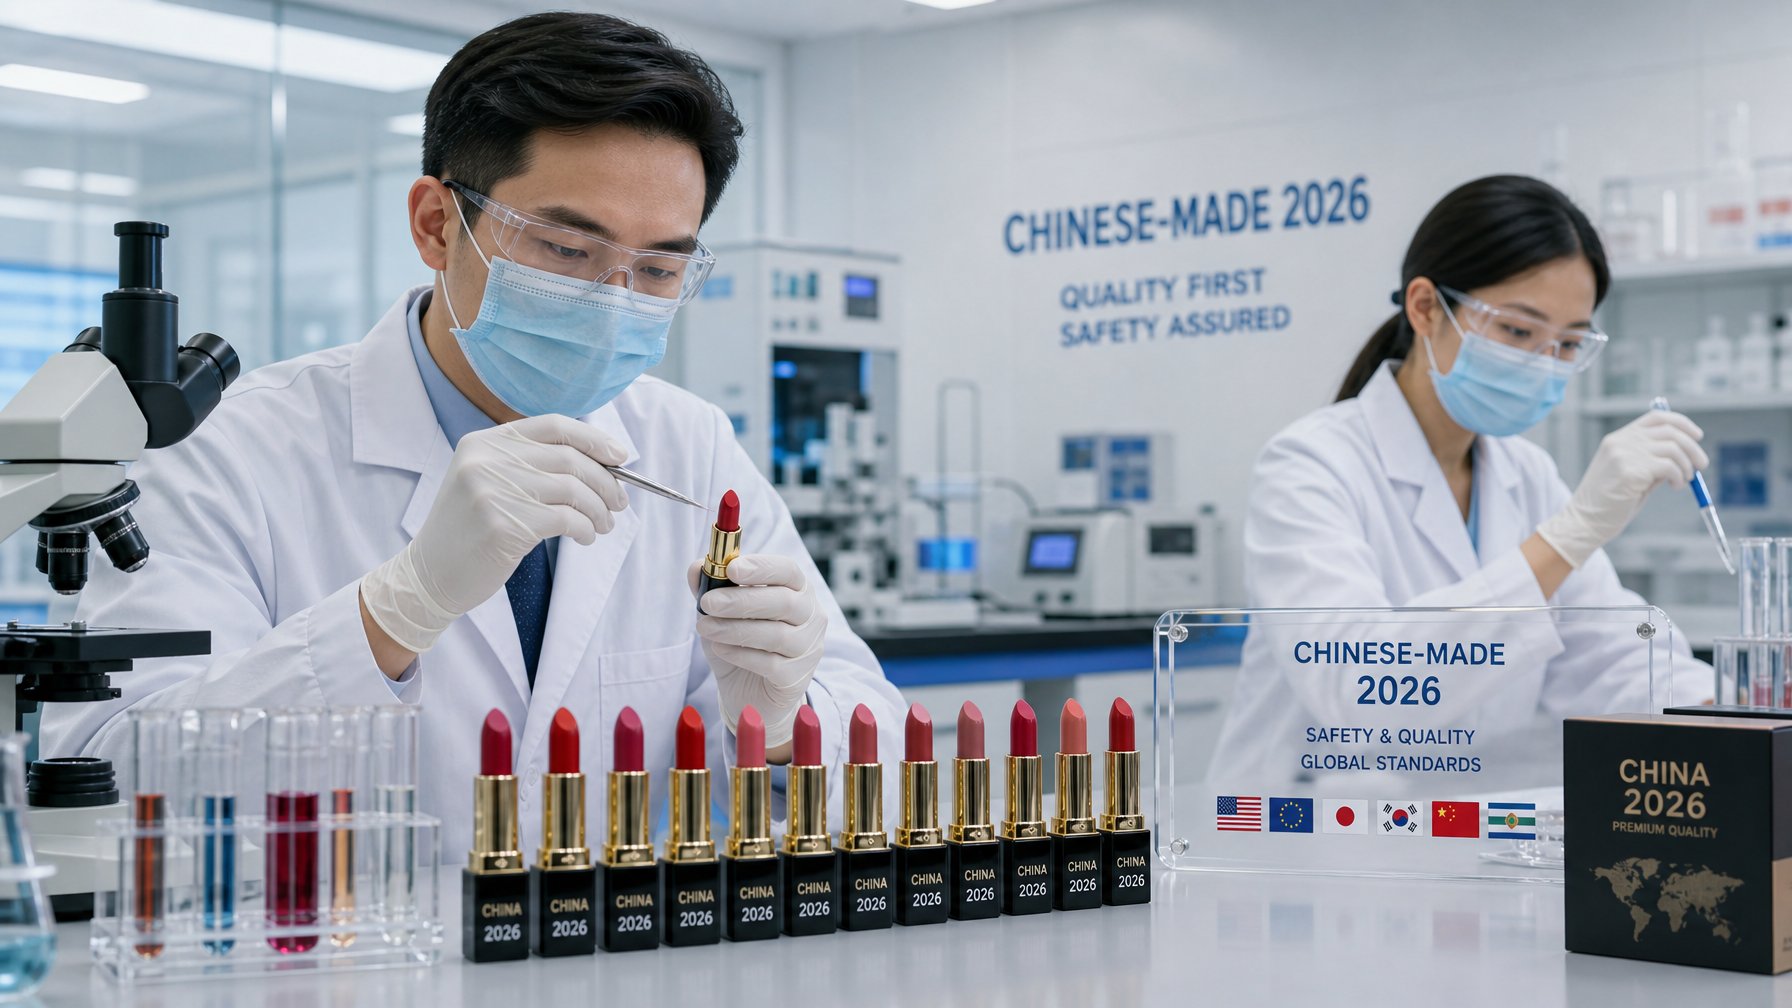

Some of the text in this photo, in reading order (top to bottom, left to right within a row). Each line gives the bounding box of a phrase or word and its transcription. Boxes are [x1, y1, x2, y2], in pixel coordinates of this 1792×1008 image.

[1003, 176, 1370, 255] CHINESE-MADE 2026
[1060, 267, 1266, 312] QUALITY FIRST
[1060, 305, 1291, 348] SAFETY ASSURED
[1294, 641, 1505, 665] CHINESE-MADE
[1357, 676, 1440, 705] 2026
[1307, 727, 1475, 745] SAFETY & QUALITY
[1301, 754, 1481, 772] GLOBAL STANDARDS
[1620, 759, 1710, 787] CHINA
[1623, 788, 1706, 819] 2026
[1613, 821, 1718, 838] PREMIUM QUALITY
[1068, 860, 1097, 872] CHINA
[1117, 856, 1145, 867] CHINA
[965, 869, 995, 881] CHINA
[1018, 864, 1047, 876] CHINA
[855, 877, 887, 890] CHINA
[911, 873, 942, 885] CHINA
[1070, 878, 1096, 892] 2026
[1119, 874, 1144, 887] 2026
[740, 886, 774, 899] CHINA
[798, 881, 831, 895] CHINA
[967, 887, 994, 902] 2026
[1019, 882, 1046, 897] 2026
[616, 894, 653, 908] CHINA
[678, 890, 714, 904] CHINA
[857, 897, 886, 912] 2026
[913, 892, 941, 906] 2026
[482, 902, 522, 918] CHINA
[550, 898, 589, 913] CHINA
[799, 901, 830, 917] 2026
[680, 910, 713, 927] 2026
[742, 906, 773, 922] 2026
[552, 919, 587, 937] 2026
[618, 915, 652, 932] 2026
[484, 924, 521, 942] 2026
